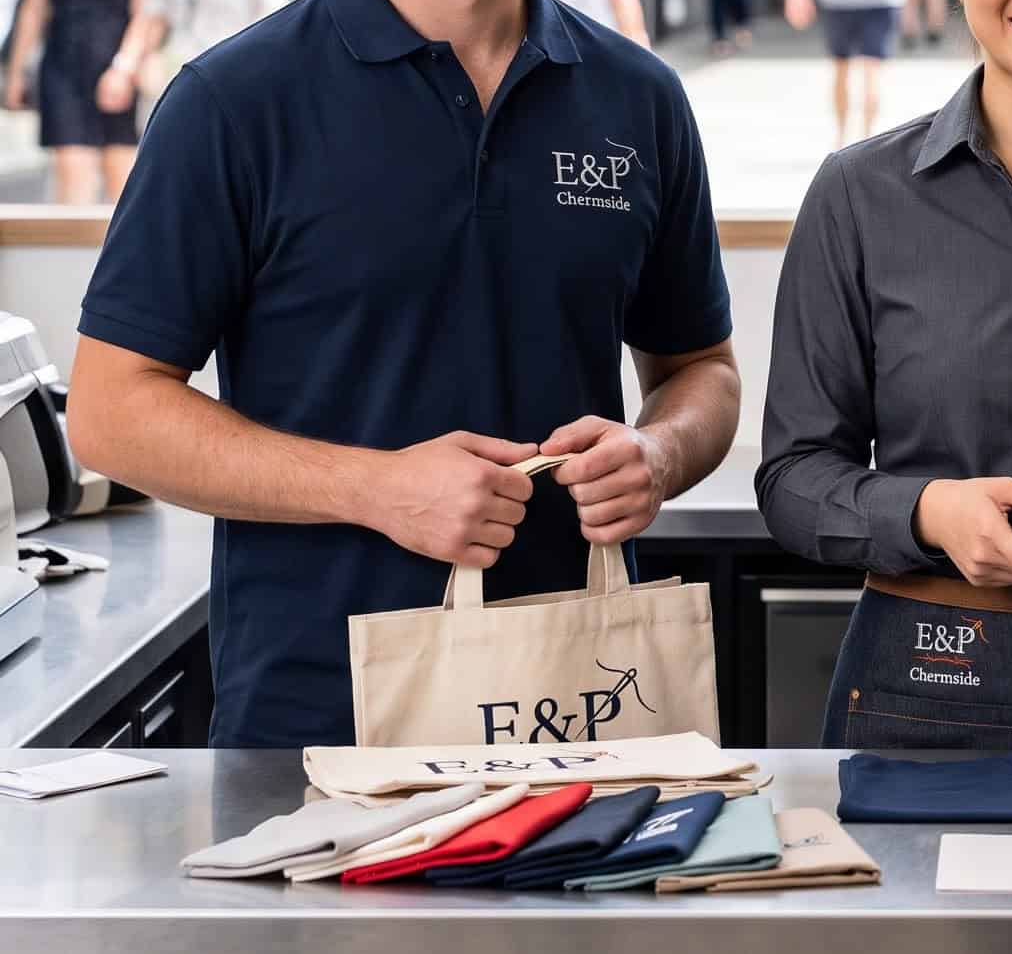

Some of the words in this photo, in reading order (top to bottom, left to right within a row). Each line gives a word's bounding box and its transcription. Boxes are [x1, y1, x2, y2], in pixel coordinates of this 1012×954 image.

[552, 151, 630, 190] E&P
[557, 191, 631, 211] Chermside
[915, 622, 975, 654] E&P
[910, 666, 981, 686] Chermside
